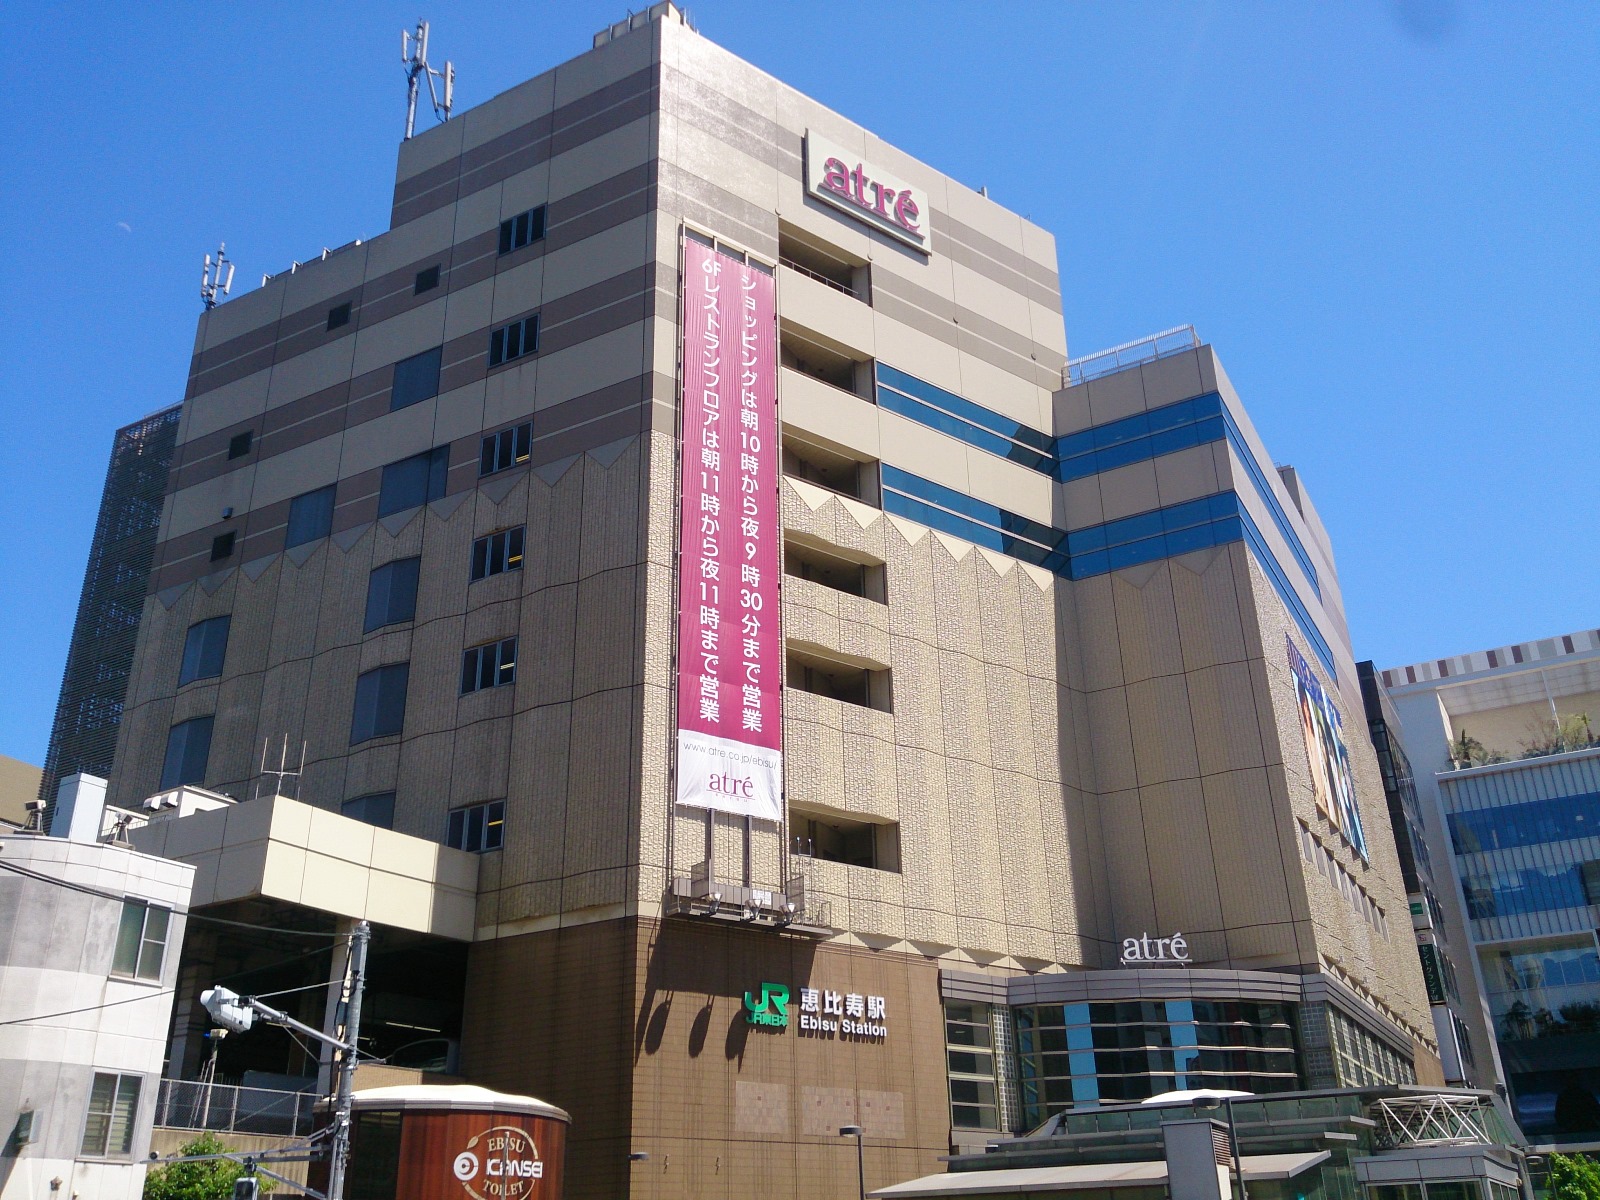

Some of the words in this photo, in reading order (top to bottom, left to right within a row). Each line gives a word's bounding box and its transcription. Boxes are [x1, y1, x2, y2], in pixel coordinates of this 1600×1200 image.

[824, 157, 920, 230] atré
[699, 258, 722, 724] 6Fレストランフロアは朝11時から夜11時まで営業
[740, 274, 763, 732] ショッピングは朝10時から夜9時30分まで営業
[709, 771, 754, 798] atré
[1123, 932, 1189, 960] atré
[744, 982, 790, 1015] JR
[800, 988, 886, 1020] 恵比寿駅
[745, 1012, 789, 1027] JR東日本
[800, 1015, 838, 1032] Ebisu
[842, 1019, 887, 1037] Station
[487, 1136, 526, 1153] EBSU
